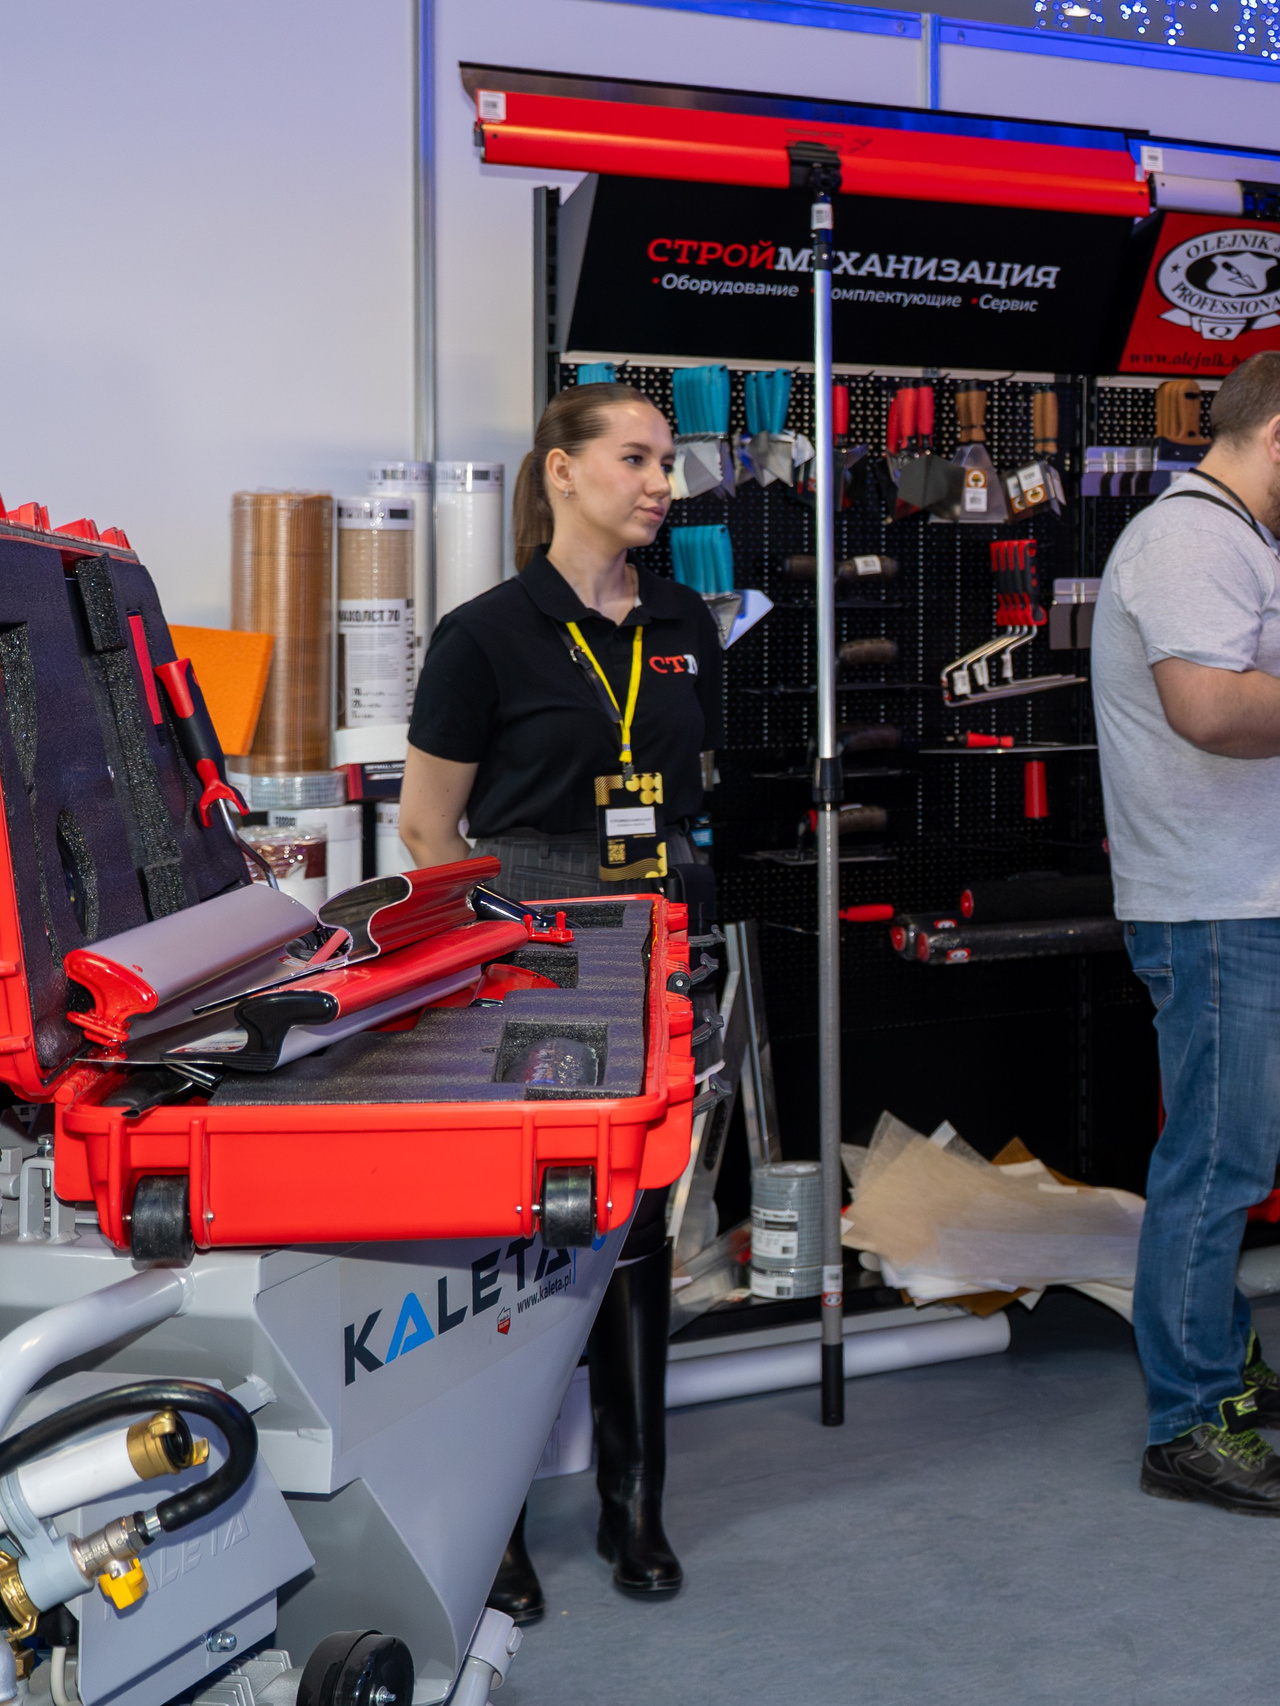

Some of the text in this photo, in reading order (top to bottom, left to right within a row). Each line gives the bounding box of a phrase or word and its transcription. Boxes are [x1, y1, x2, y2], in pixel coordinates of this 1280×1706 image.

[647, 238, 1060, 290] СТРОЙМХАНИЗАЦИЯ
[1186, 234, 1274, 259] OLEJNIK
[661, 273, 1039, 313] Оборудование омплектующие Сервис
[344, 1233, 572, 1387] KALETA
[516, 1269, 572, 1314] www.kaleta.pl
